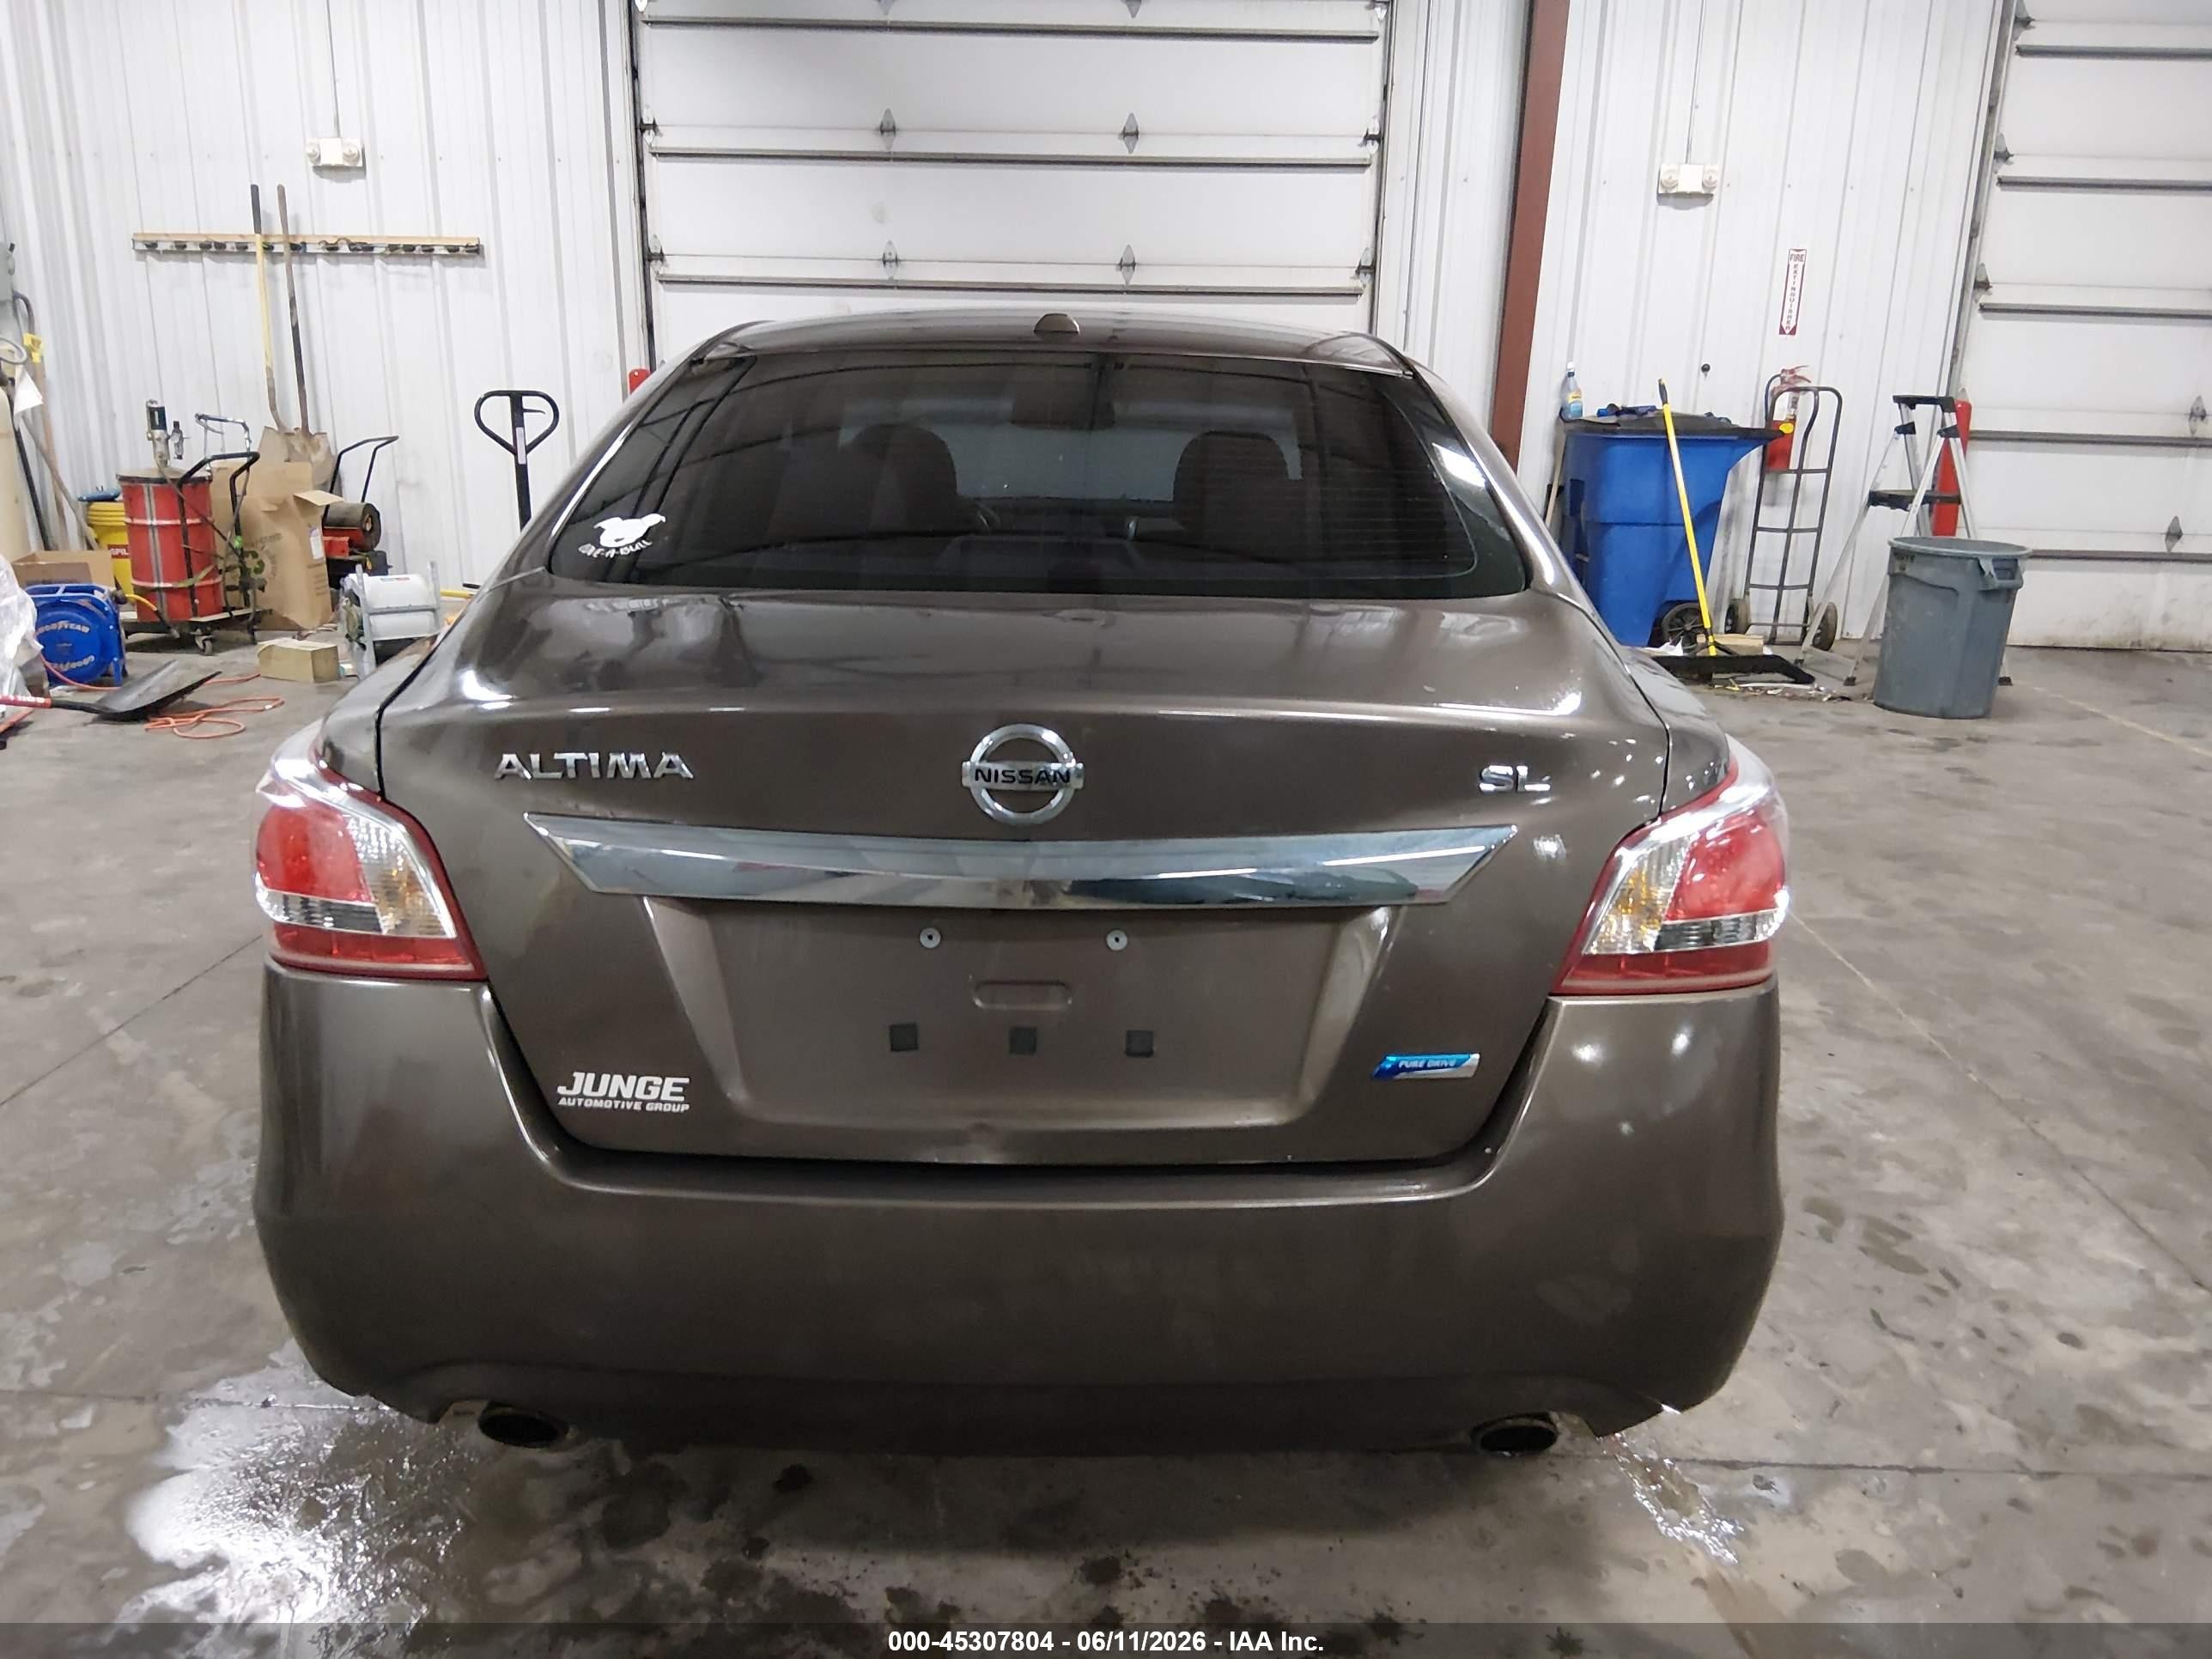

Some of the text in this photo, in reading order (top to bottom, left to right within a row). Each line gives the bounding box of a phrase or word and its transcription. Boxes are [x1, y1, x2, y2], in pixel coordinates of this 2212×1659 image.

[1785, 264, 1798, 331] EXTINGUISHER
[495, 752, 694, 781] ALTIMA
[975, 769, 1071, 784] NISSAN
[1480, 765, 1551, 792] SL
[557, 1072, 690, 1101] JUNGE
[558, 1097, 690, 1113] AUTOMOTIVE GROUP
